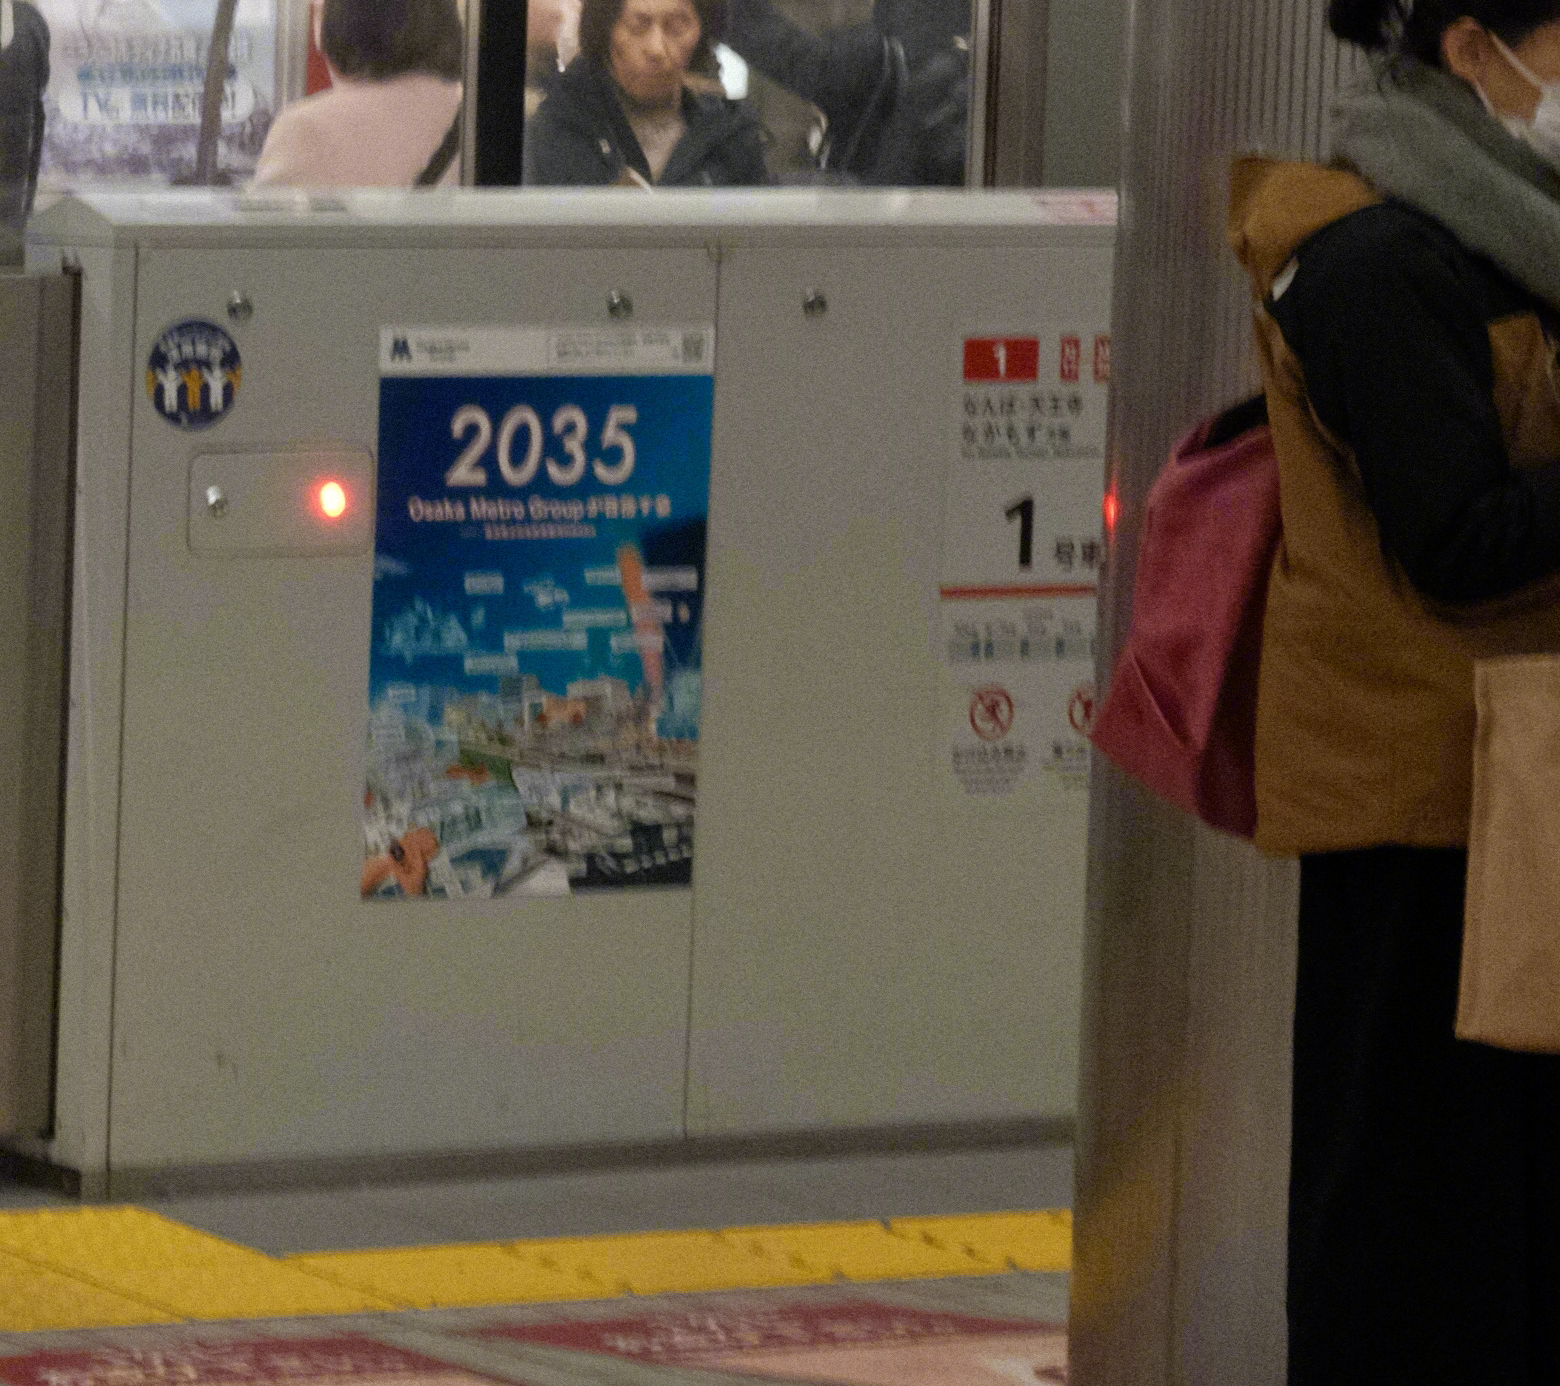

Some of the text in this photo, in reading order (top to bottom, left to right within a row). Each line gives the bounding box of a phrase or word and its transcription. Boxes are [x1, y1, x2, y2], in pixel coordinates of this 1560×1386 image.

[993, 343, 1007, 377] 1
[445, 403, 639, 488] 2035
[408, 495, 467, 522] Osaka
[470, 495, 526, 521] Metro
[527, 494, 584, 522] Group
